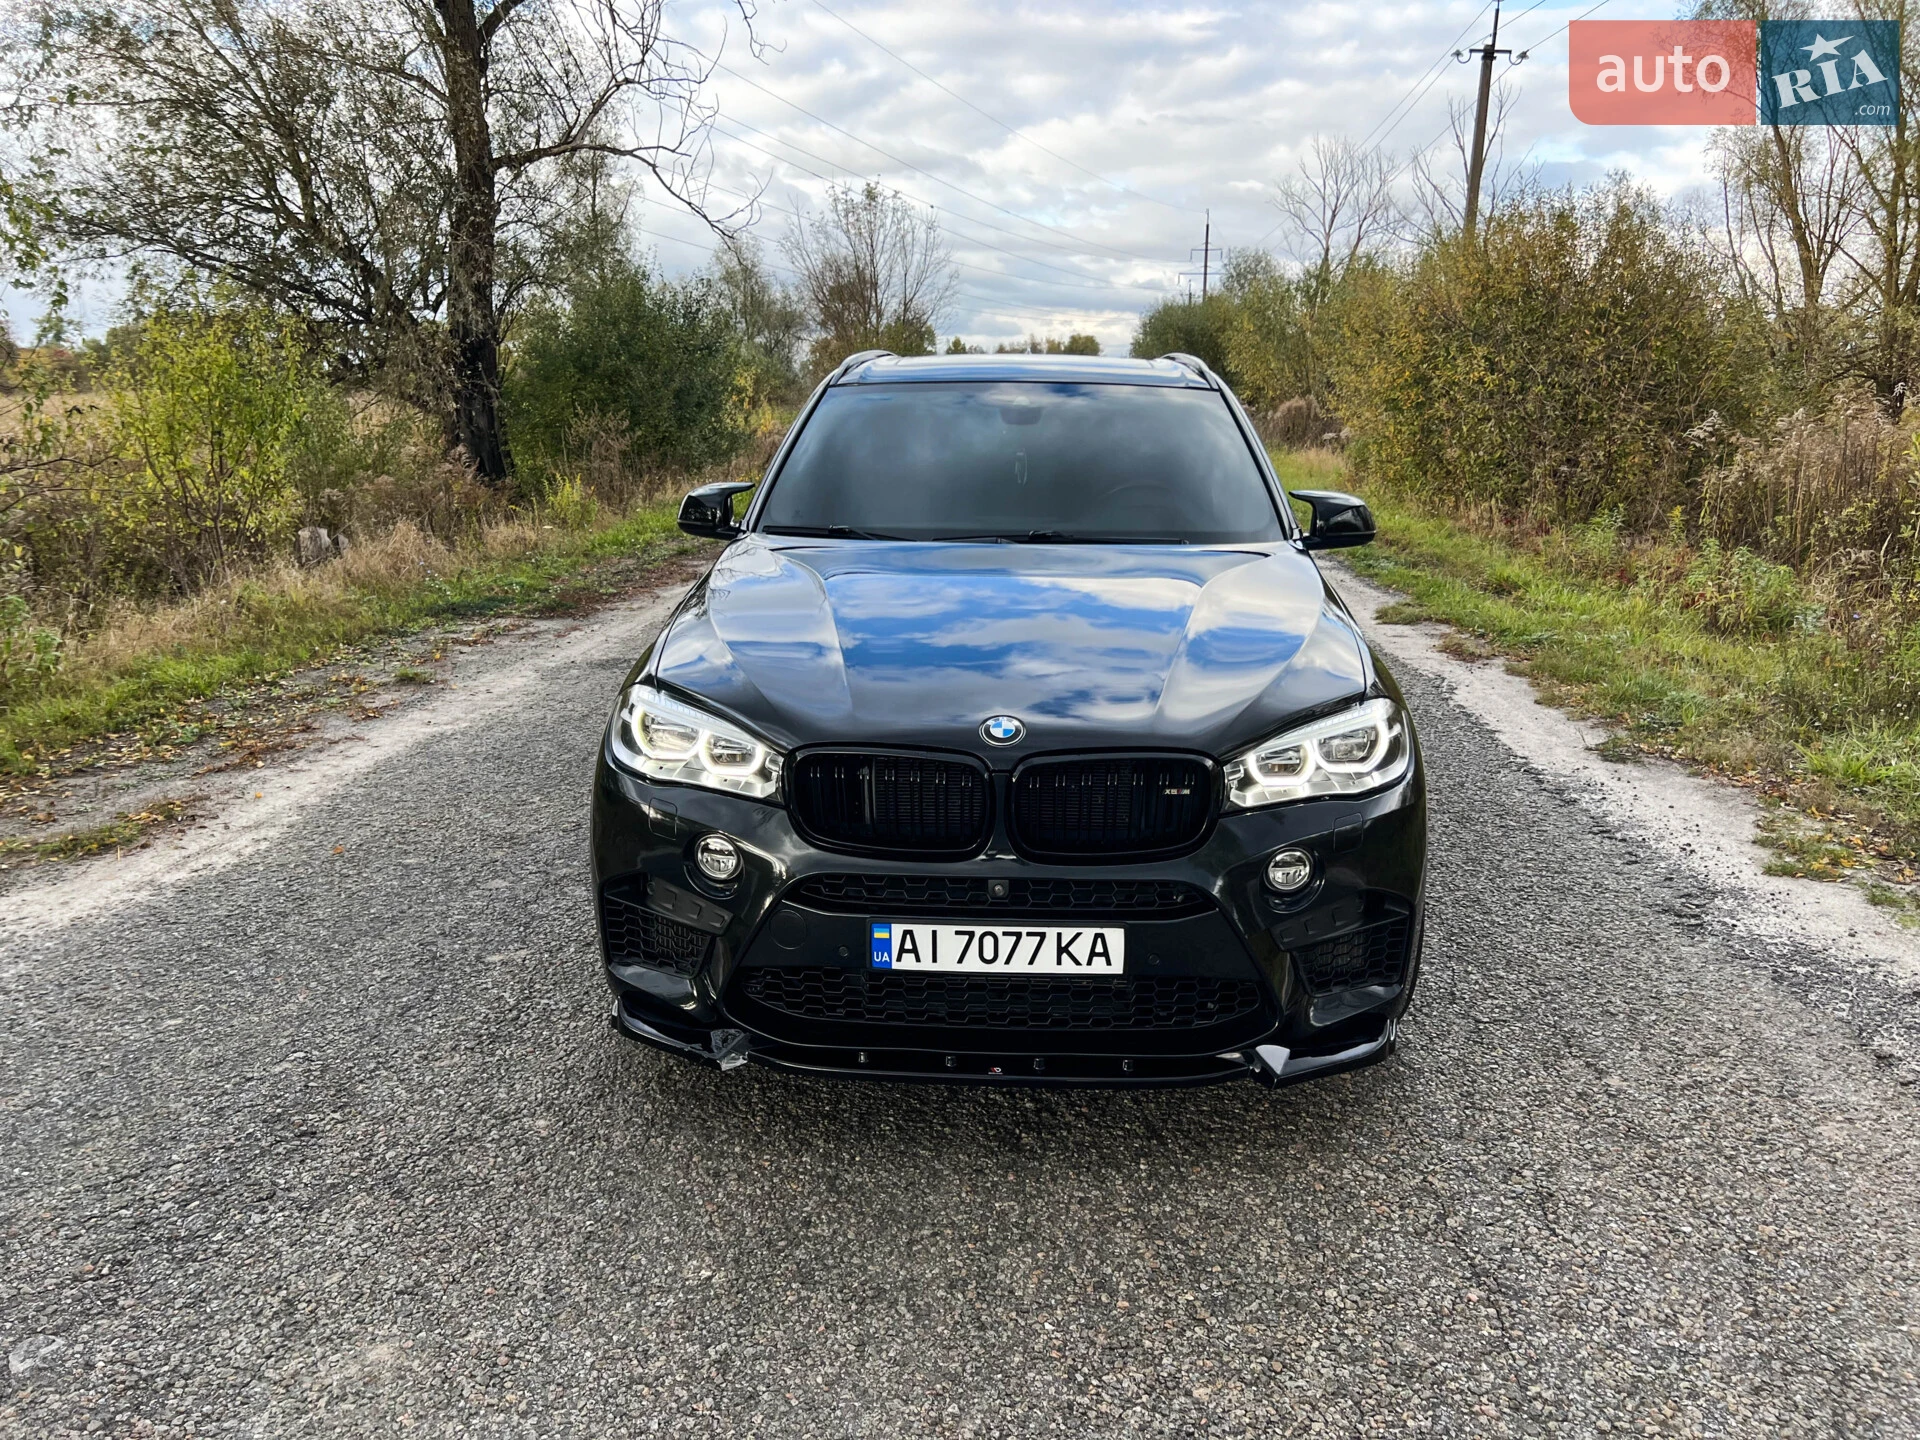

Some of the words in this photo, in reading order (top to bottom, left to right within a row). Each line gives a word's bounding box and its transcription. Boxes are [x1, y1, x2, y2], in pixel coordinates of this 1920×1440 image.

[873, 951, 890, 963] UA
[895, 929, 938, 964] AI
[954, 930, 1047, 966] 7077
[1056, 931, 1113, 967] KA
